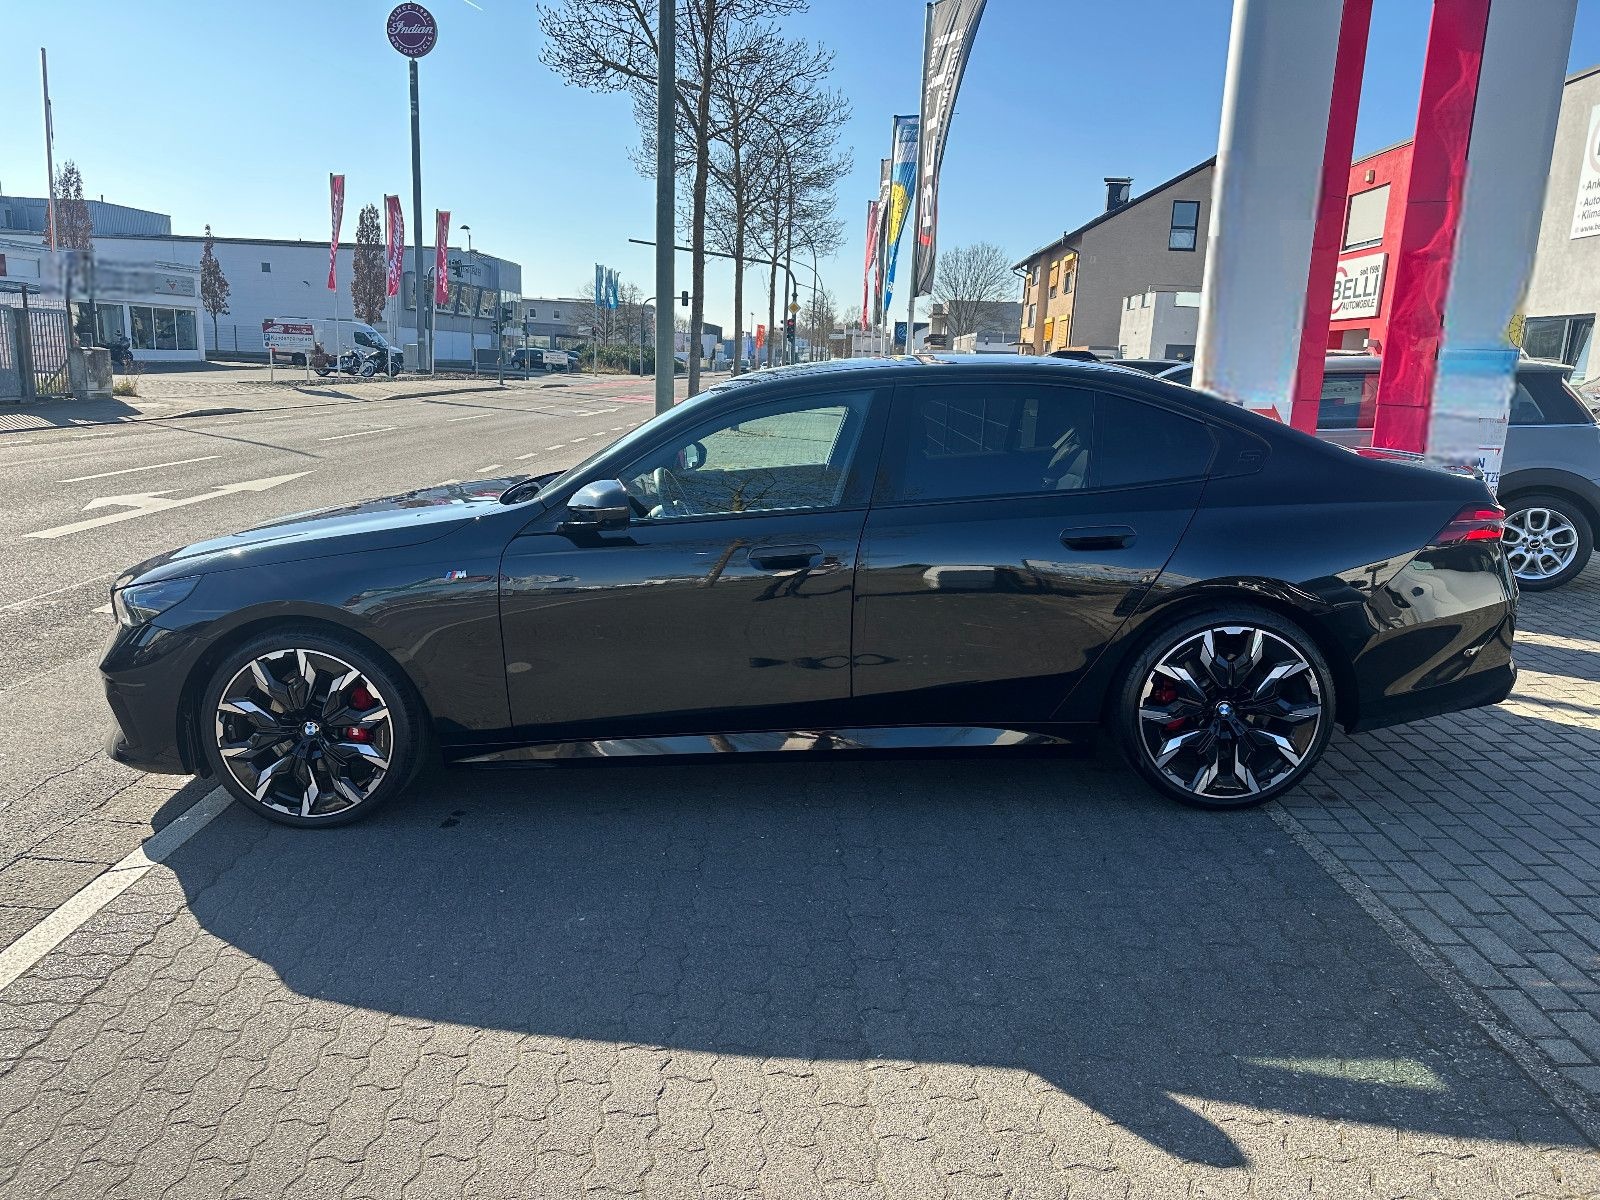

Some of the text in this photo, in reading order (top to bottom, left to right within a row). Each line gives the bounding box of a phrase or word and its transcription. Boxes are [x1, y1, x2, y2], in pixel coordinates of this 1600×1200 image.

[391, 5, 431, 20] SINCE 1901
[388, 21, 433, 34] Indian
[390, 36, 433, 54] MOTORCYCLE
[1360, 267, 1369, 276] seit
[1333, 274, 1379, 300] BELLI
[1342, 298, 1376, 310] AUTOMOBILE
